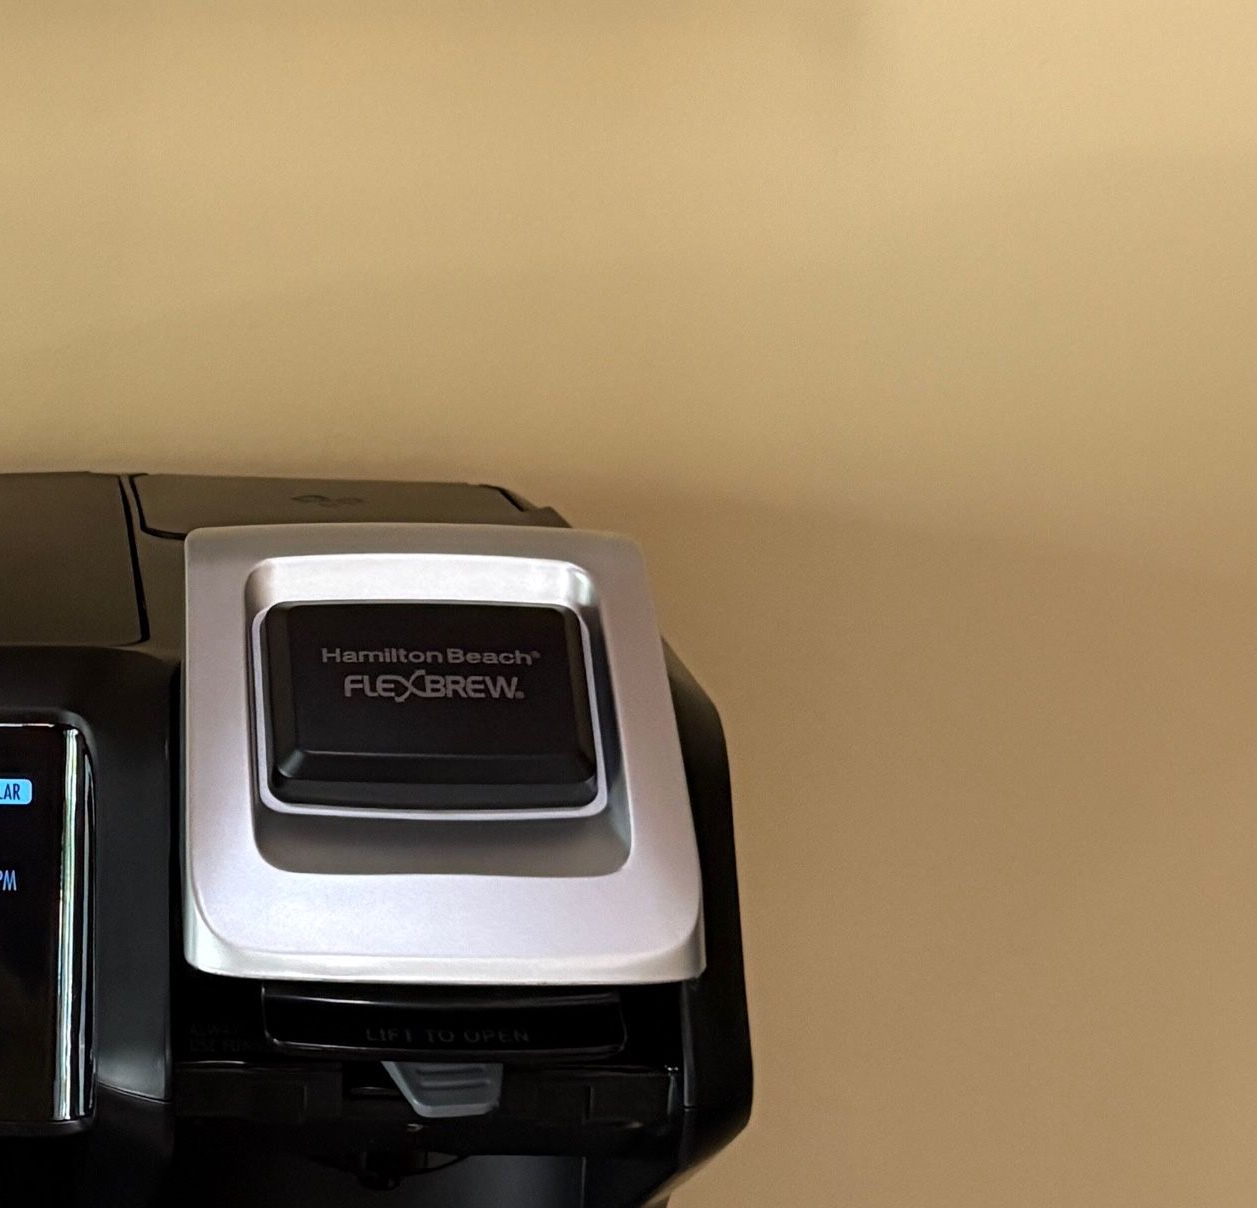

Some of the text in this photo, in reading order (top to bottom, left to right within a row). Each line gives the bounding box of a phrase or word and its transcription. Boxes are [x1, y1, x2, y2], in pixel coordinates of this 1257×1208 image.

[321, 648, 443, 664] Hamilton
[425, 1028, 455, 1043] TO
[464, 1027, 531, 1043] OPEN
